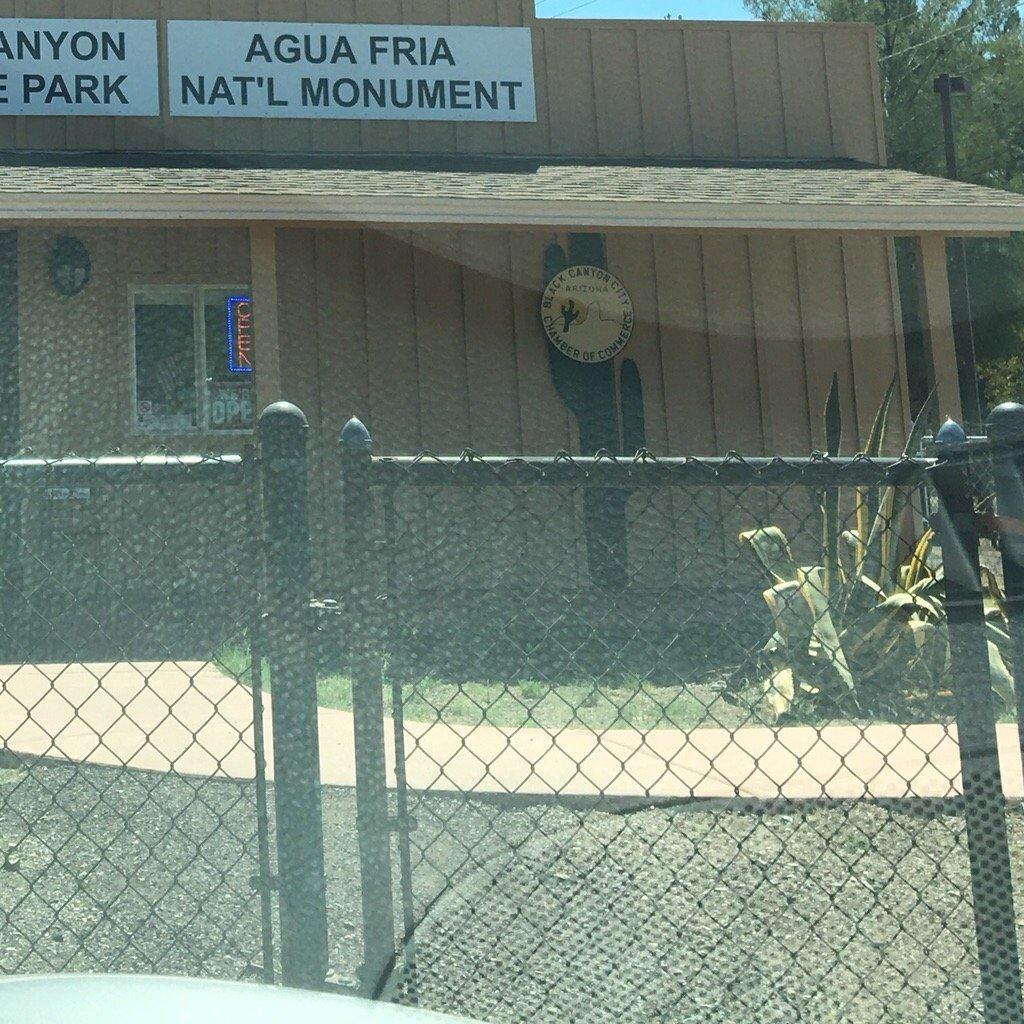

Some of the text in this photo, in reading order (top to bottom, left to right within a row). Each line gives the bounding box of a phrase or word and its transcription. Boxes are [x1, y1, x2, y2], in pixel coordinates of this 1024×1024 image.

[244, 33, 457, 67] AGUA FRIA
[22, 73, 130, 106] PARK
[181, 75, 523, 111] NAT'L MONUMENT
[542, 267, 630, 309] BLACK CANYON CITY
[543, 310, 633, 362] CHAMBER OF COMMERCE
